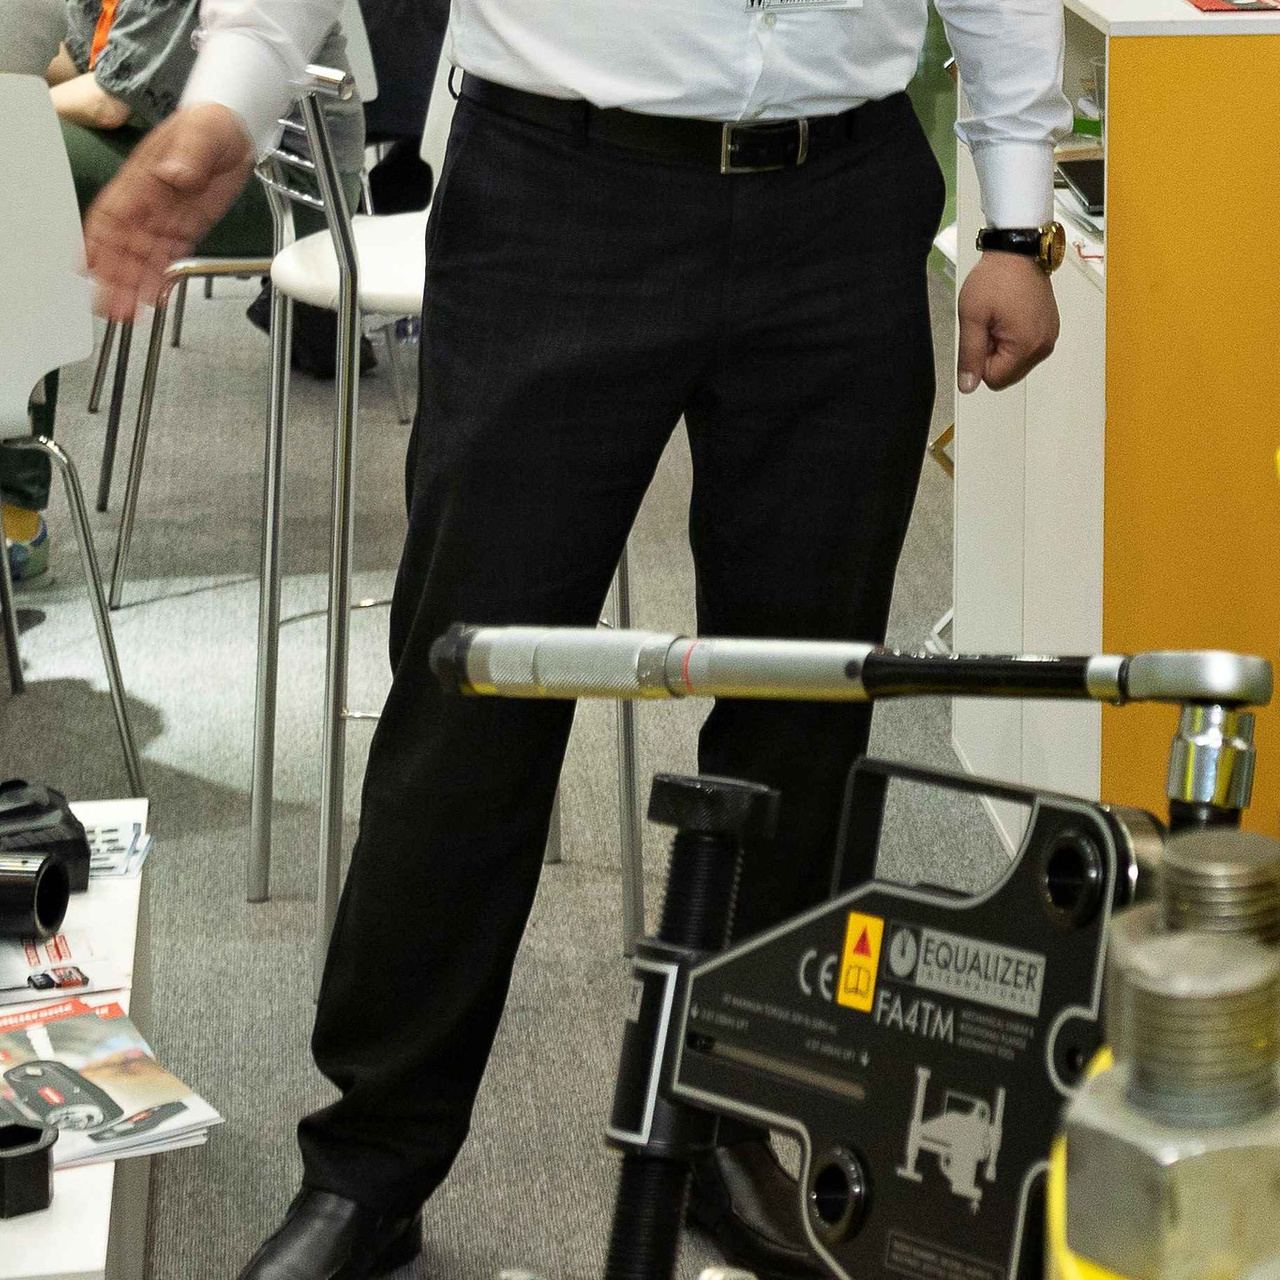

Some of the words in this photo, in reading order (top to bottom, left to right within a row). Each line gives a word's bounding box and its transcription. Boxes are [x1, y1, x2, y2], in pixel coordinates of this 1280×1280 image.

[798, 948, 839, 1003] CE
[921, 936, 1039, 993] EQUALIZER
[874, 987, 955, 1045] FA4TM
